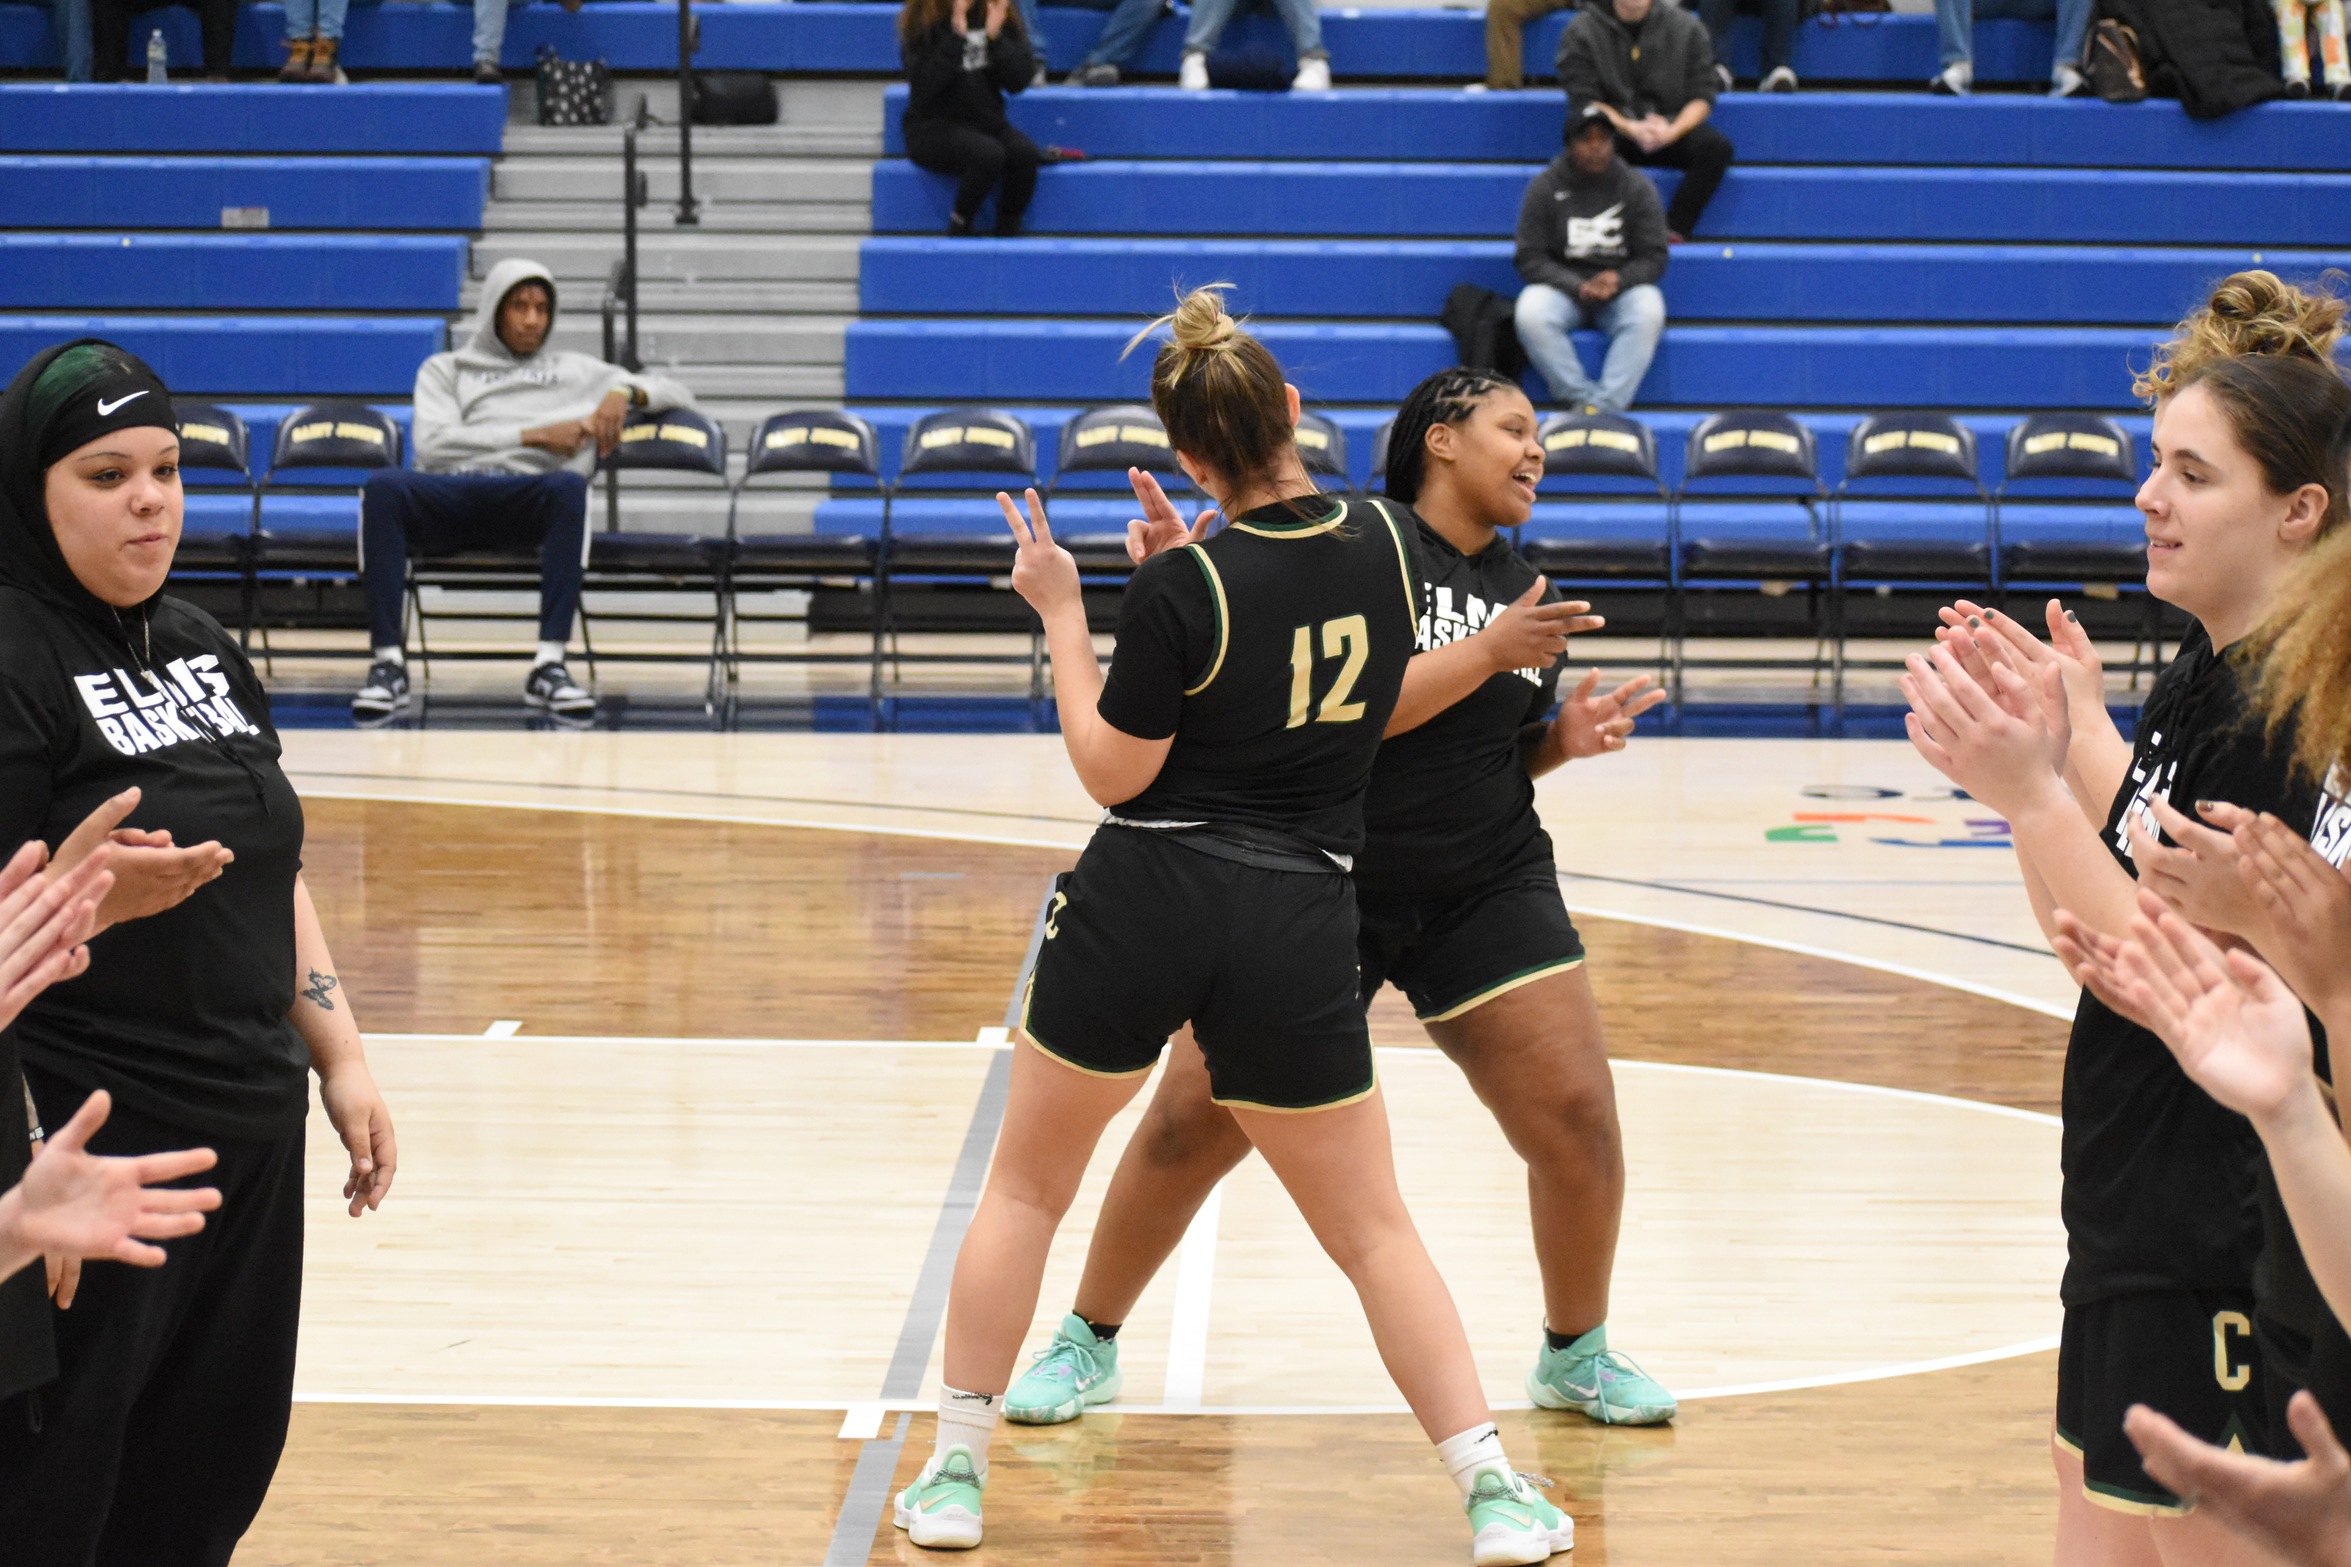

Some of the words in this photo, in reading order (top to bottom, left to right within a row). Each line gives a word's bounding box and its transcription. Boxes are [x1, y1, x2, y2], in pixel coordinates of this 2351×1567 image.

[1424, 581, 1507, 629] LM
[1285, 612, 1369, 729] 12
[2212, 1310, 2251, 1391] C
